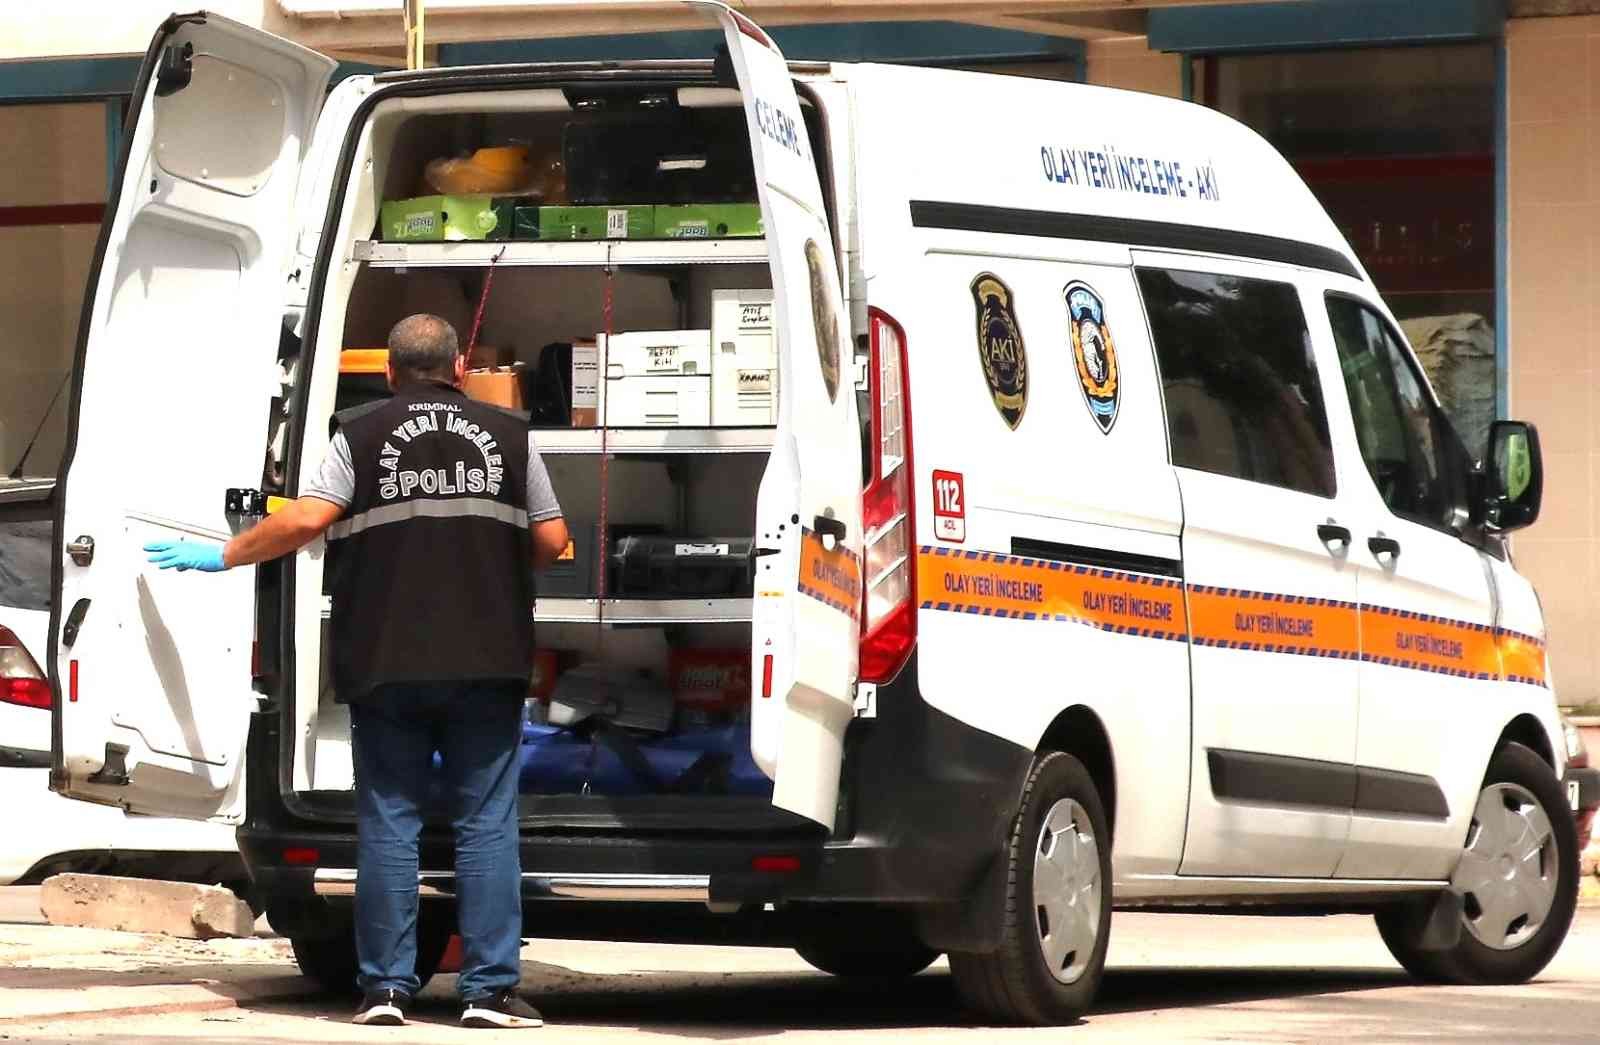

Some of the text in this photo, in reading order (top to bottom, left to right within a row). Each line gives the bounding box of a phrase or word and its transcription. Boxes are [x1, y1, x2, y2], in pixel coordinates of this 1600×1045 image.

[1040, 145, 1079, 185] OLAY
[1078, 144, 1116, 189] YERİ
[1111, 145, 1187, 197] İNCELEME
[379, 441, 401, 499] OLAY
[399, 461, 486, 497] POLİS
[936, 478, 961, 513] 112
[944, 572, 1043, 603] OLAY YERİ İNCELEME
[1083, 591, 1172, 622] OLAY YERİ İNCELEME
[1235, 612, 1255, 633] OLAY
